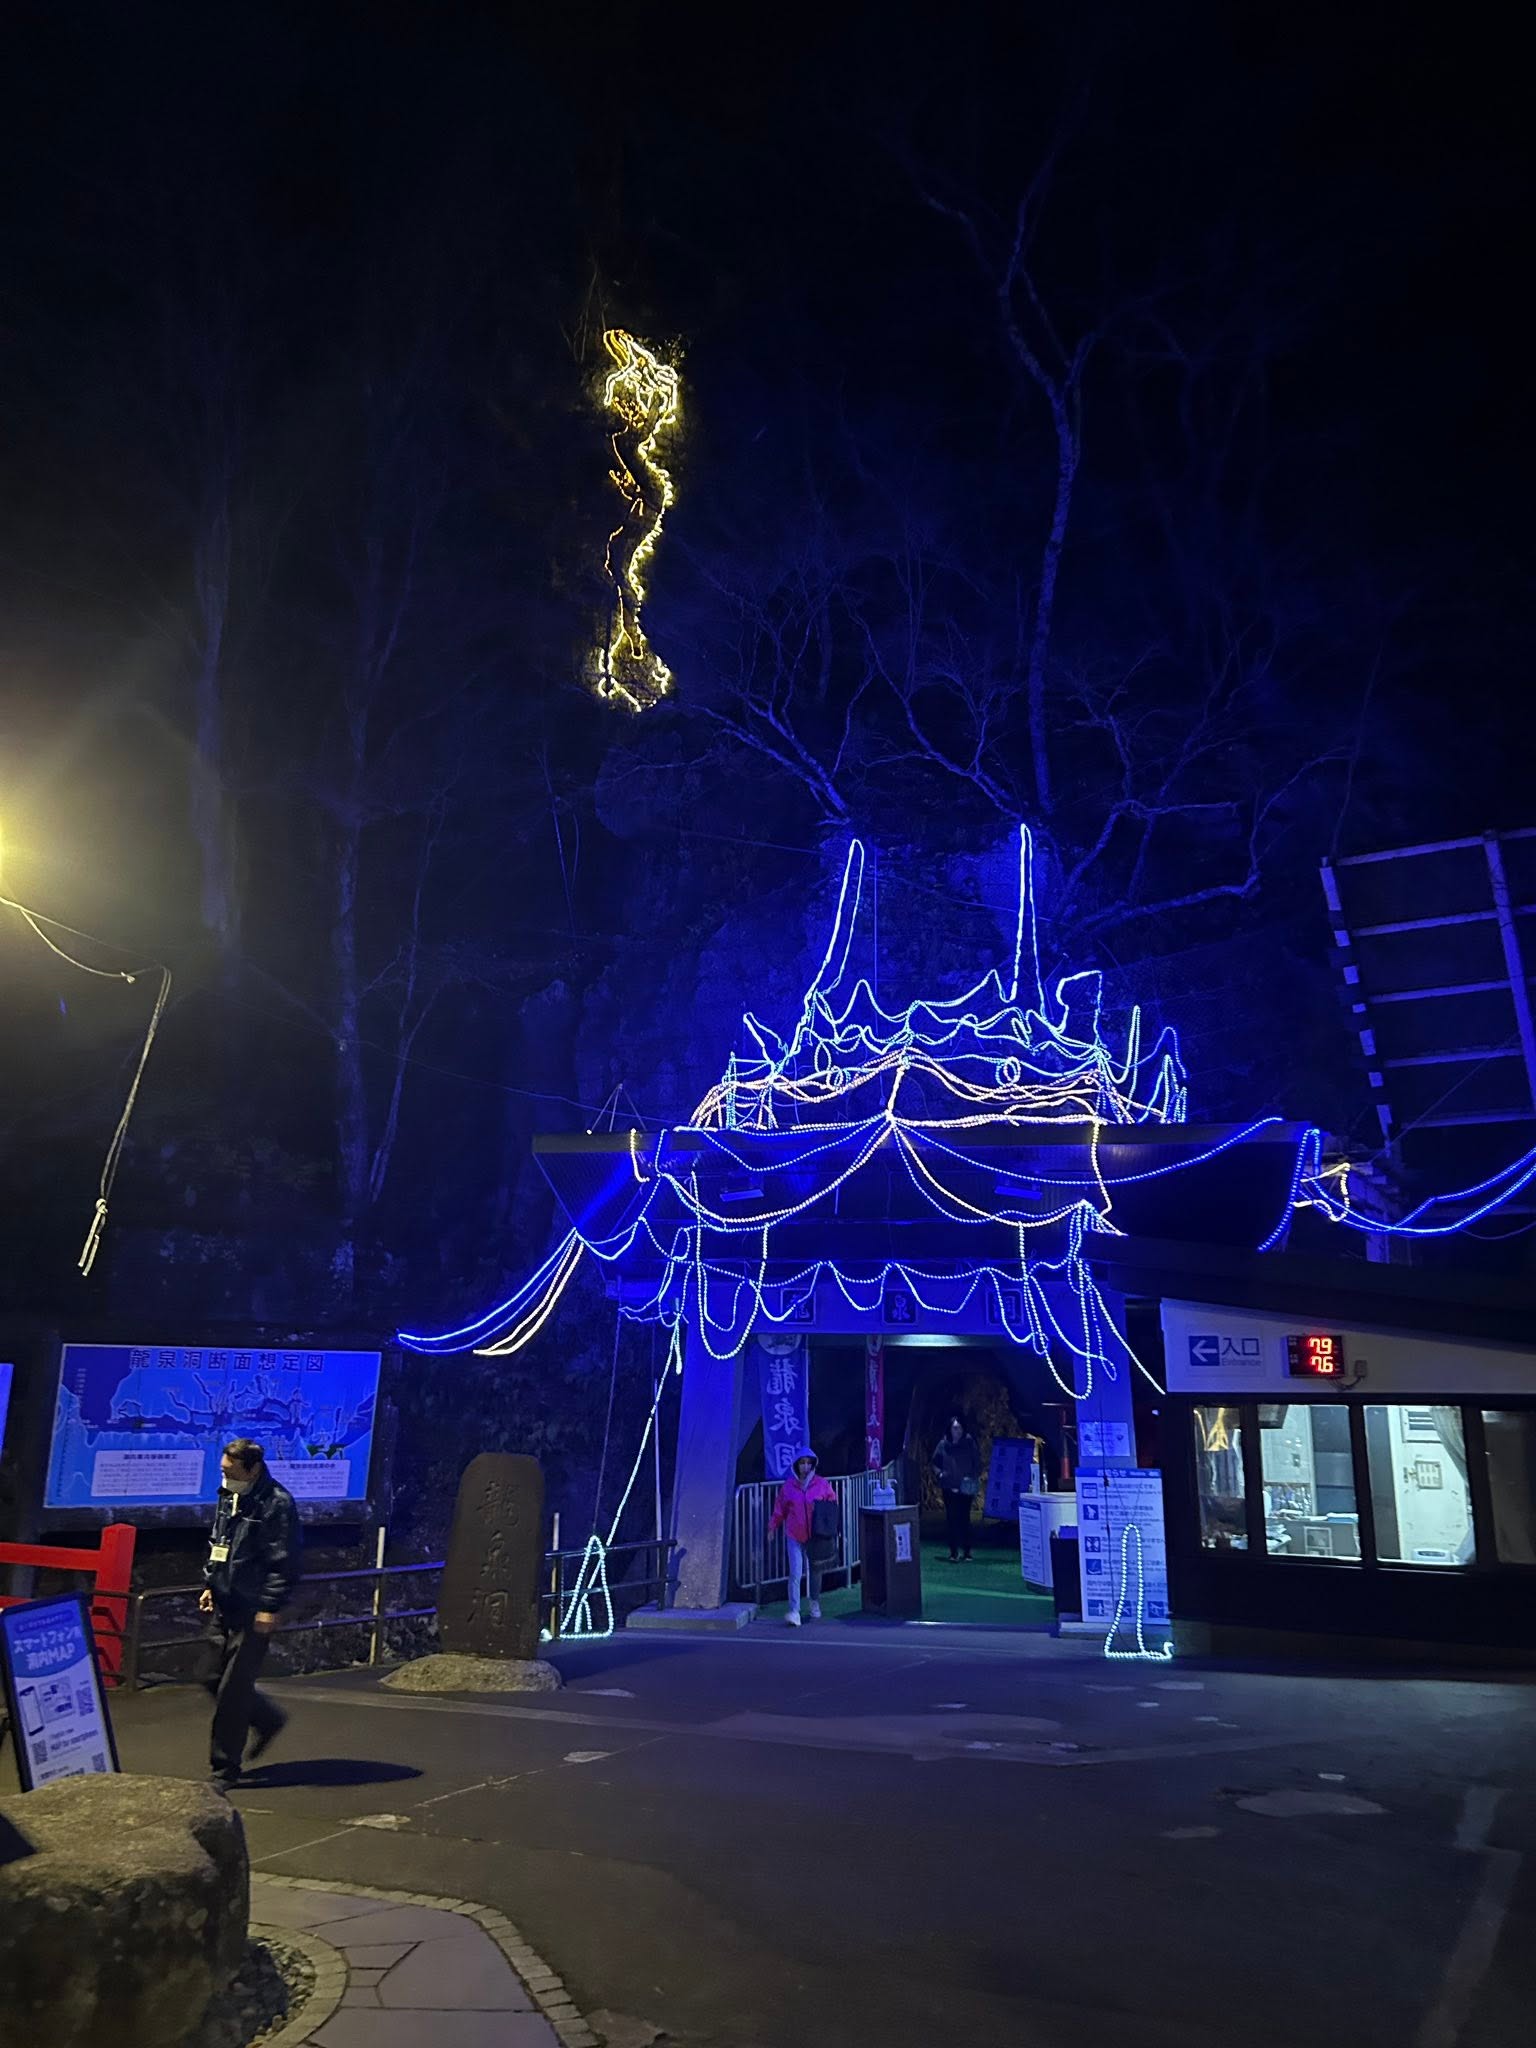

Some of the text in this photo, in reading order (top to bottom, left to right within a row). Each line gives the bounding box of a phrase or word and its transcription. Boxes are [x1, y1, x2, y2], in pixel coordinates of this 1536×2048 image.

[1221, 1337, 1260, 1356] 入口
[129, 1349, 326, 1372] 龍泉洞断面想定図
[1222, 1358, 1262, 1367] Entrance
[467, 1480, 520, 1628] 龍泉洞
